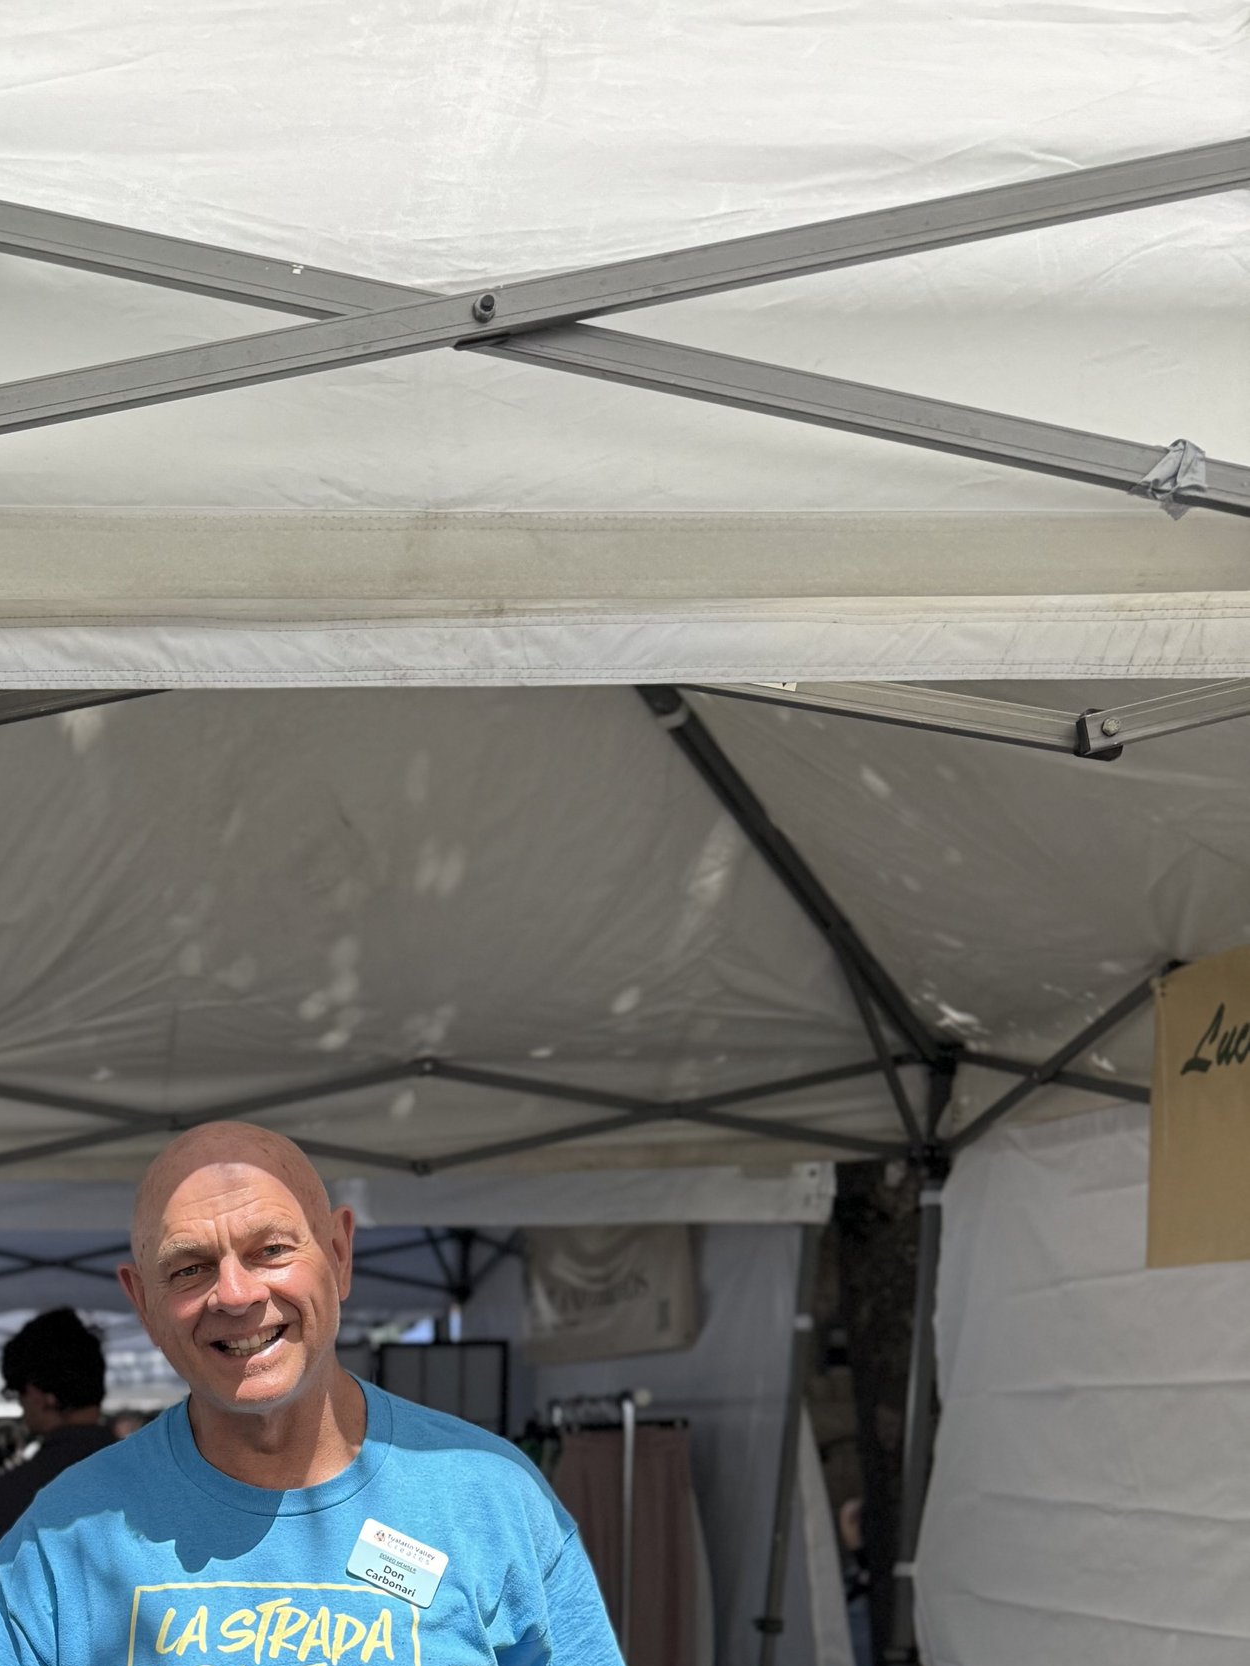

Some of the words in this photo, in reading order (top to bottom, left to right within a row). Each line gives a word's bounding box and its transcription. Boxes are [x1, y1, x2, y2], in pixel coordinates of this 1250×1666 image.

[415, 1546, 436, 1561] Valley
[365, 1568, 417, 1597] Carbonari
[383, 1565, 405, 1581] Don
[155, 1605, 208, 1656] LA
[217, 1597, 395, 1665] STRADA
